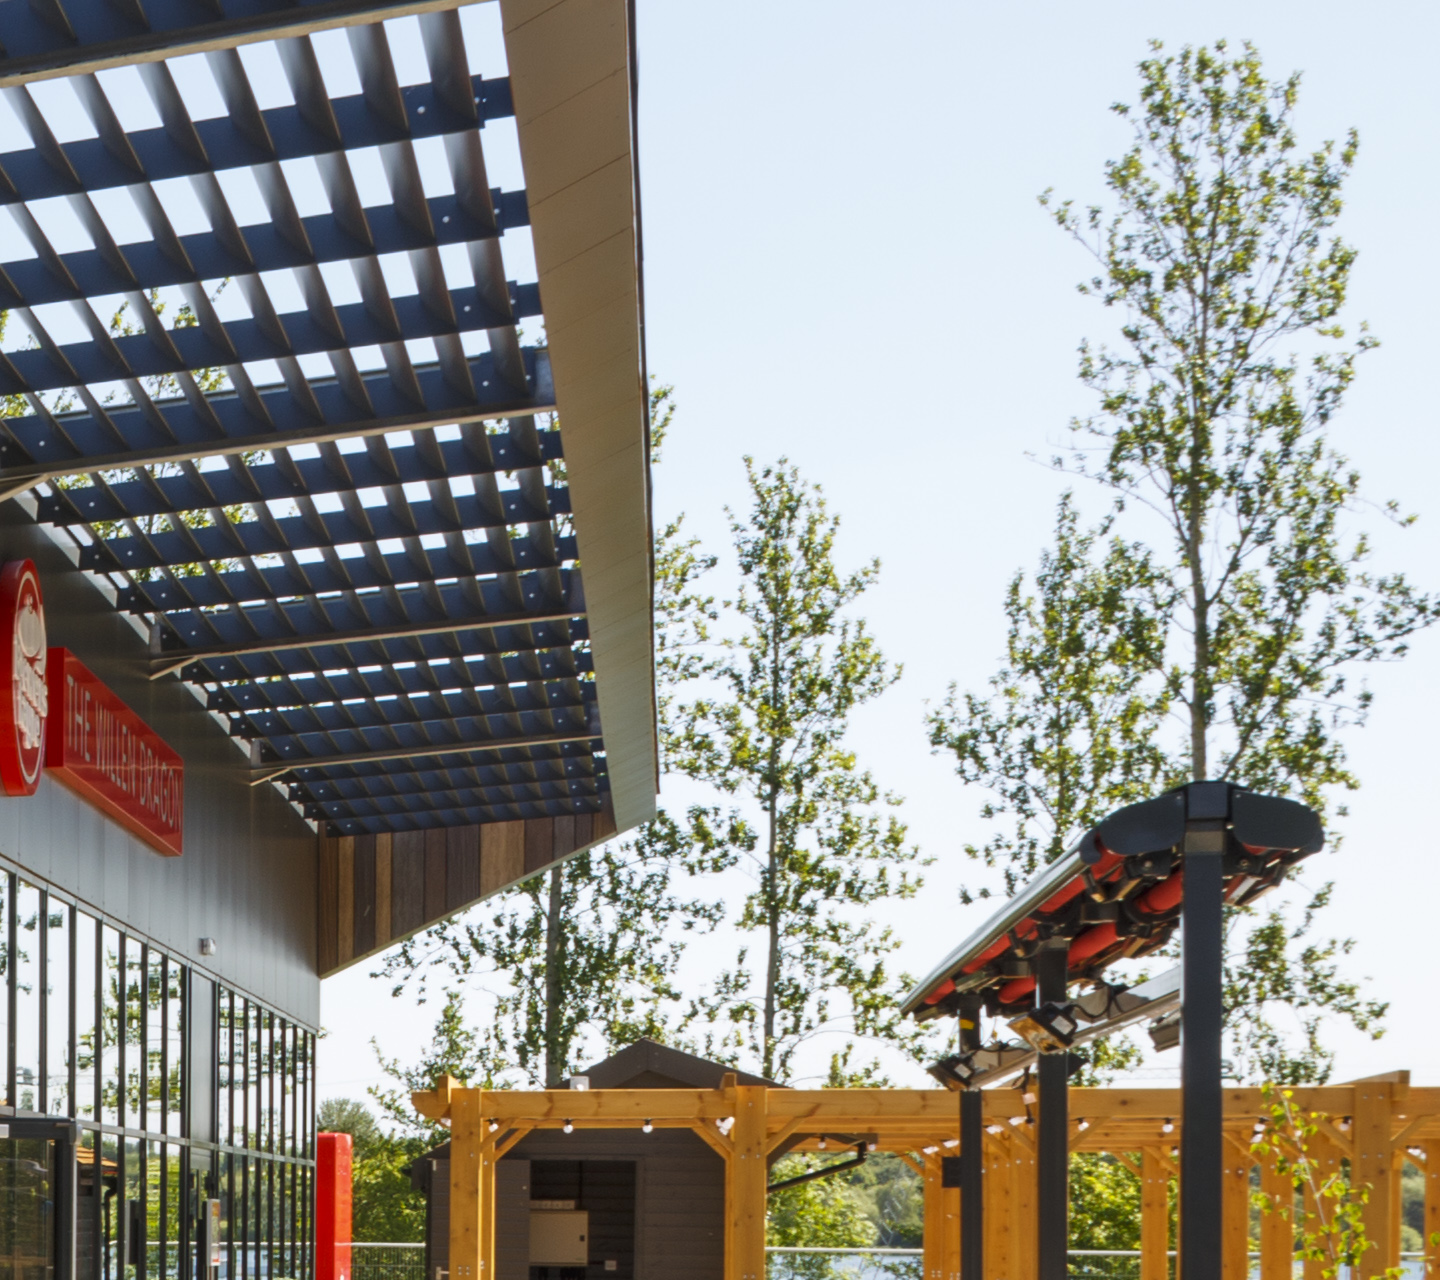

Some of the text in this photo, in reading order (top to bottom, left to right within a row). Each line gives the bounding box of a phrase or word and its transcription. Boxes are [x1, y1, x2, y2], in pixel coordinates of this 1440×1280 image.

[67, 673, 91, 762] THE
[95, 700, 136, 798] WILLEN
[139, 741, 183, 833] DRAGON
